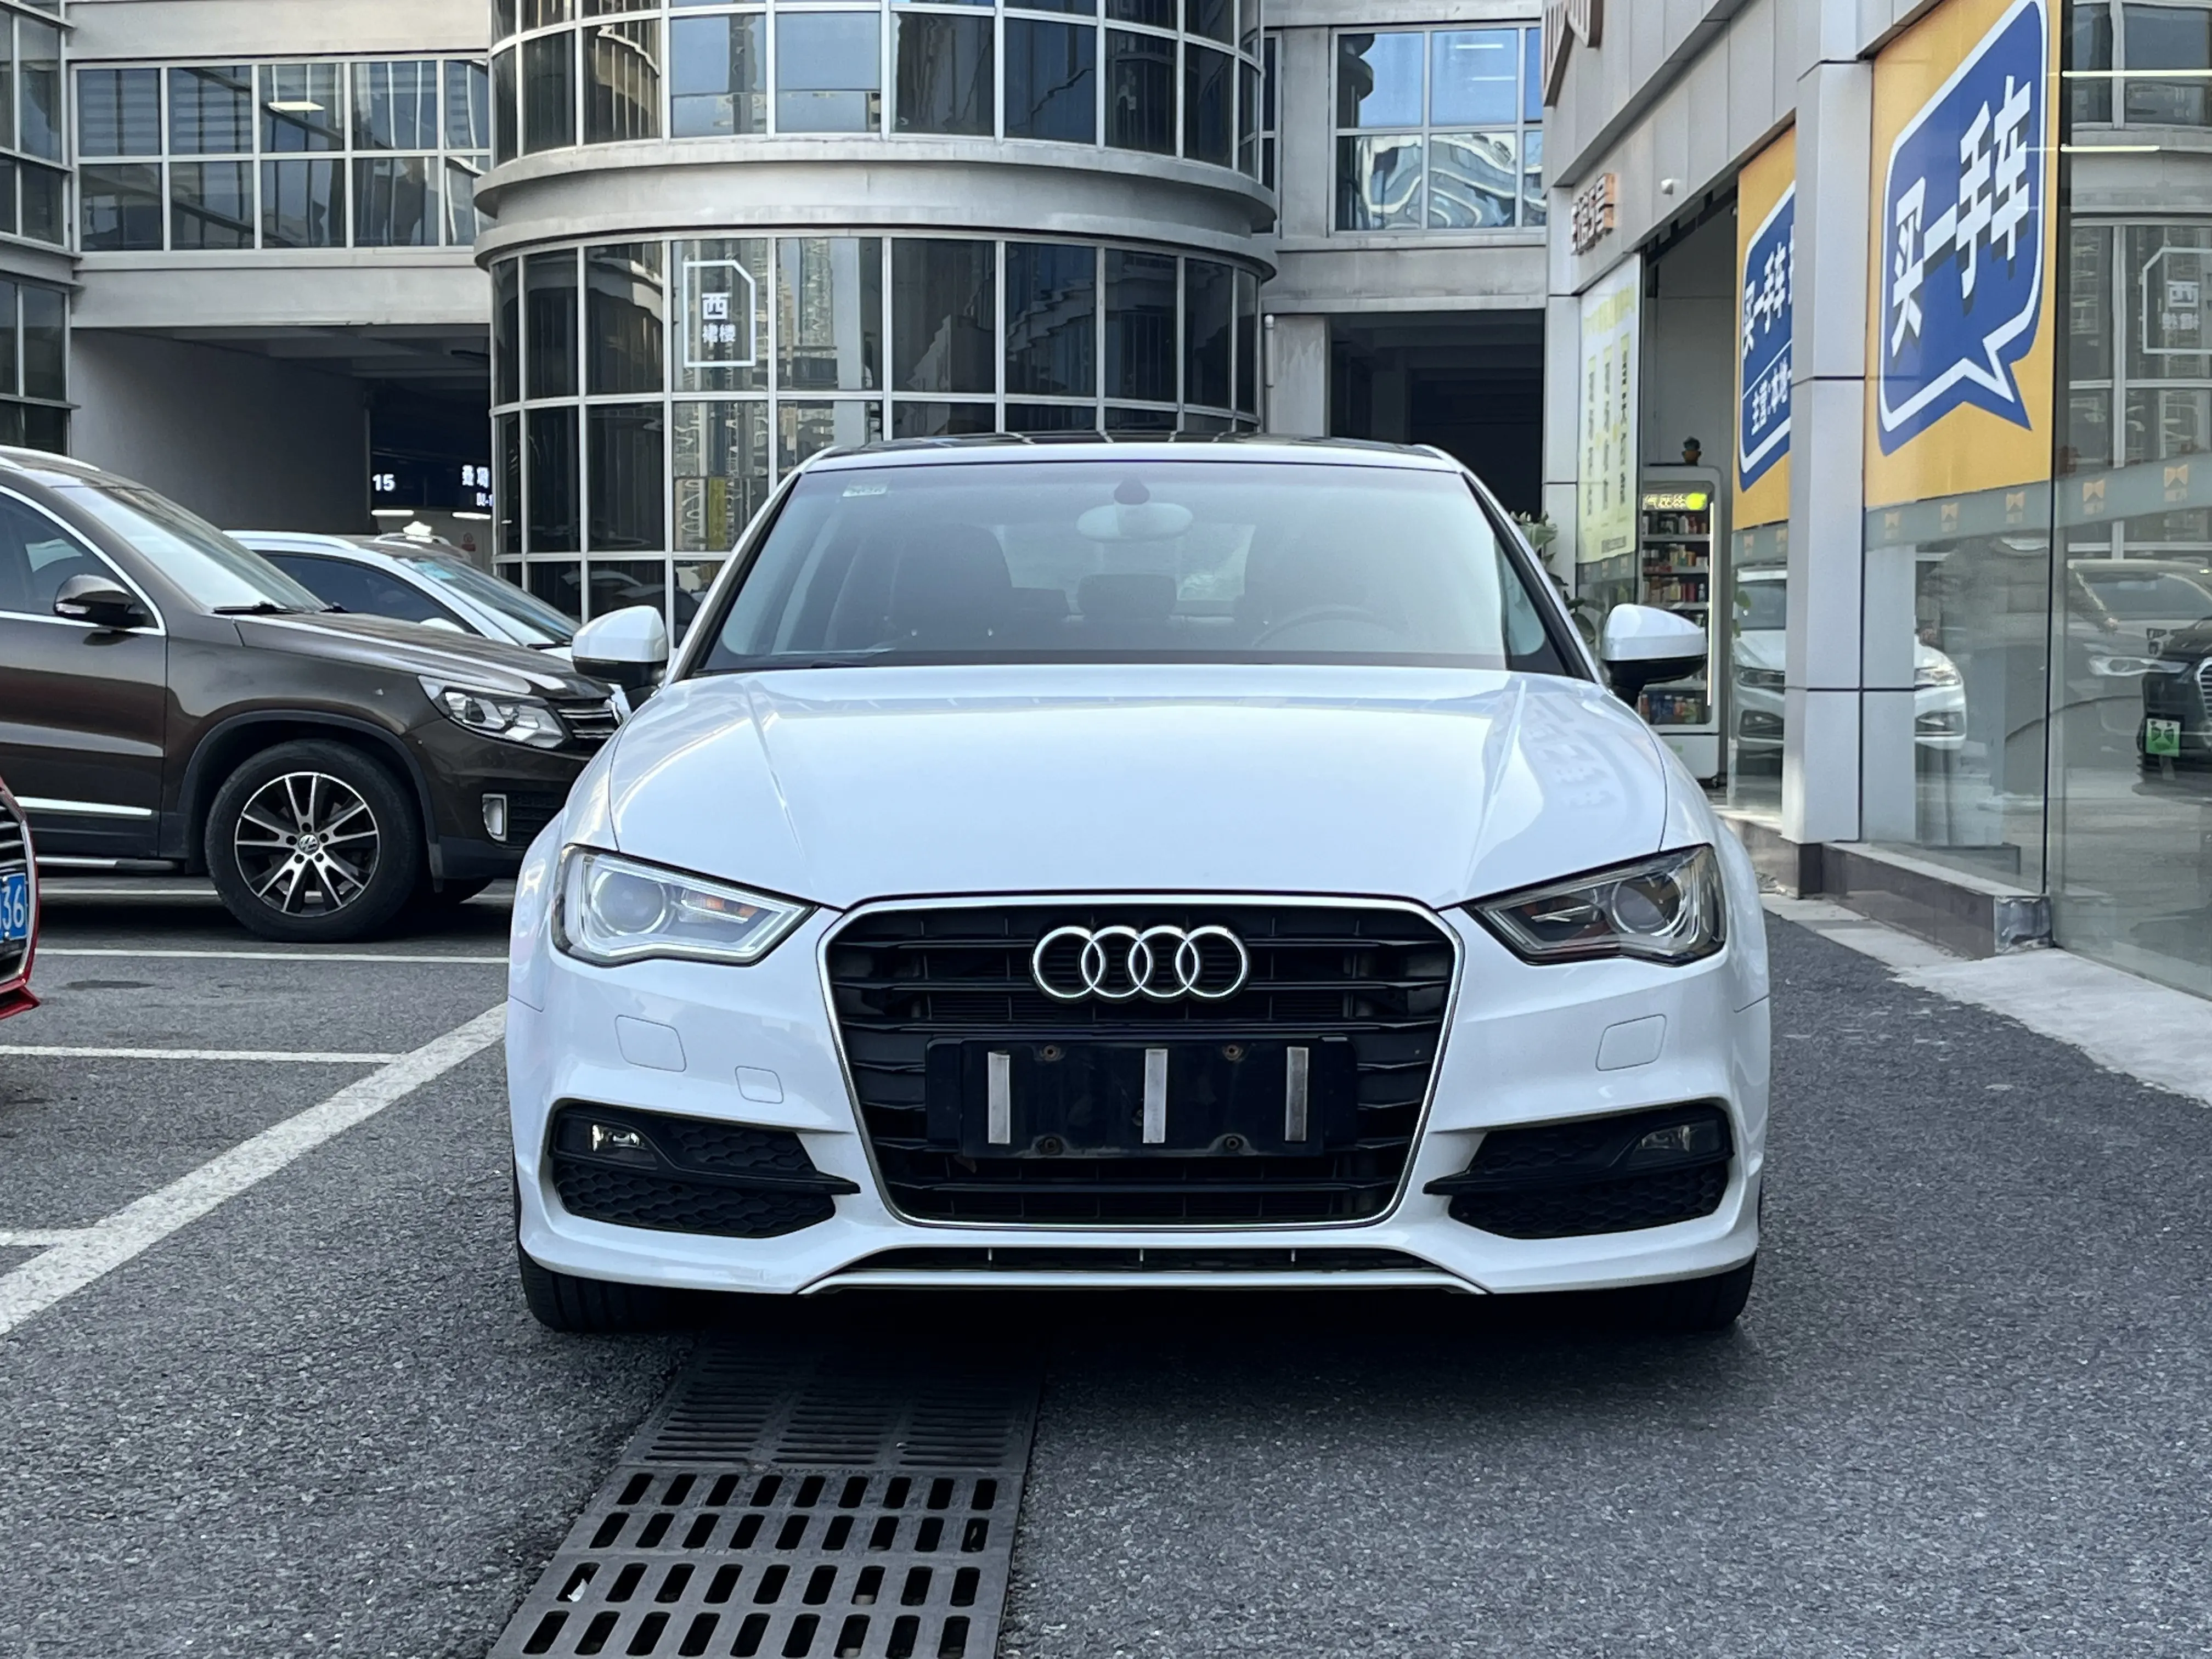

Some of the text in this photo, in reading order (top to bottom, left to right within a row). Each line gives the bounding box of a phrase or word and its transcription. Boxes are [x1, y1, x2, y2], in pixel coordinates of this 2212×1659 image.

[1891, 75, 2031, 357] 买一手车
[701, 292, 730, 320] 西
[1743, 224, 1794, 360] 买一手车
[372, 473, 396, 492] 15
[0, 884, 24, 930] 36
